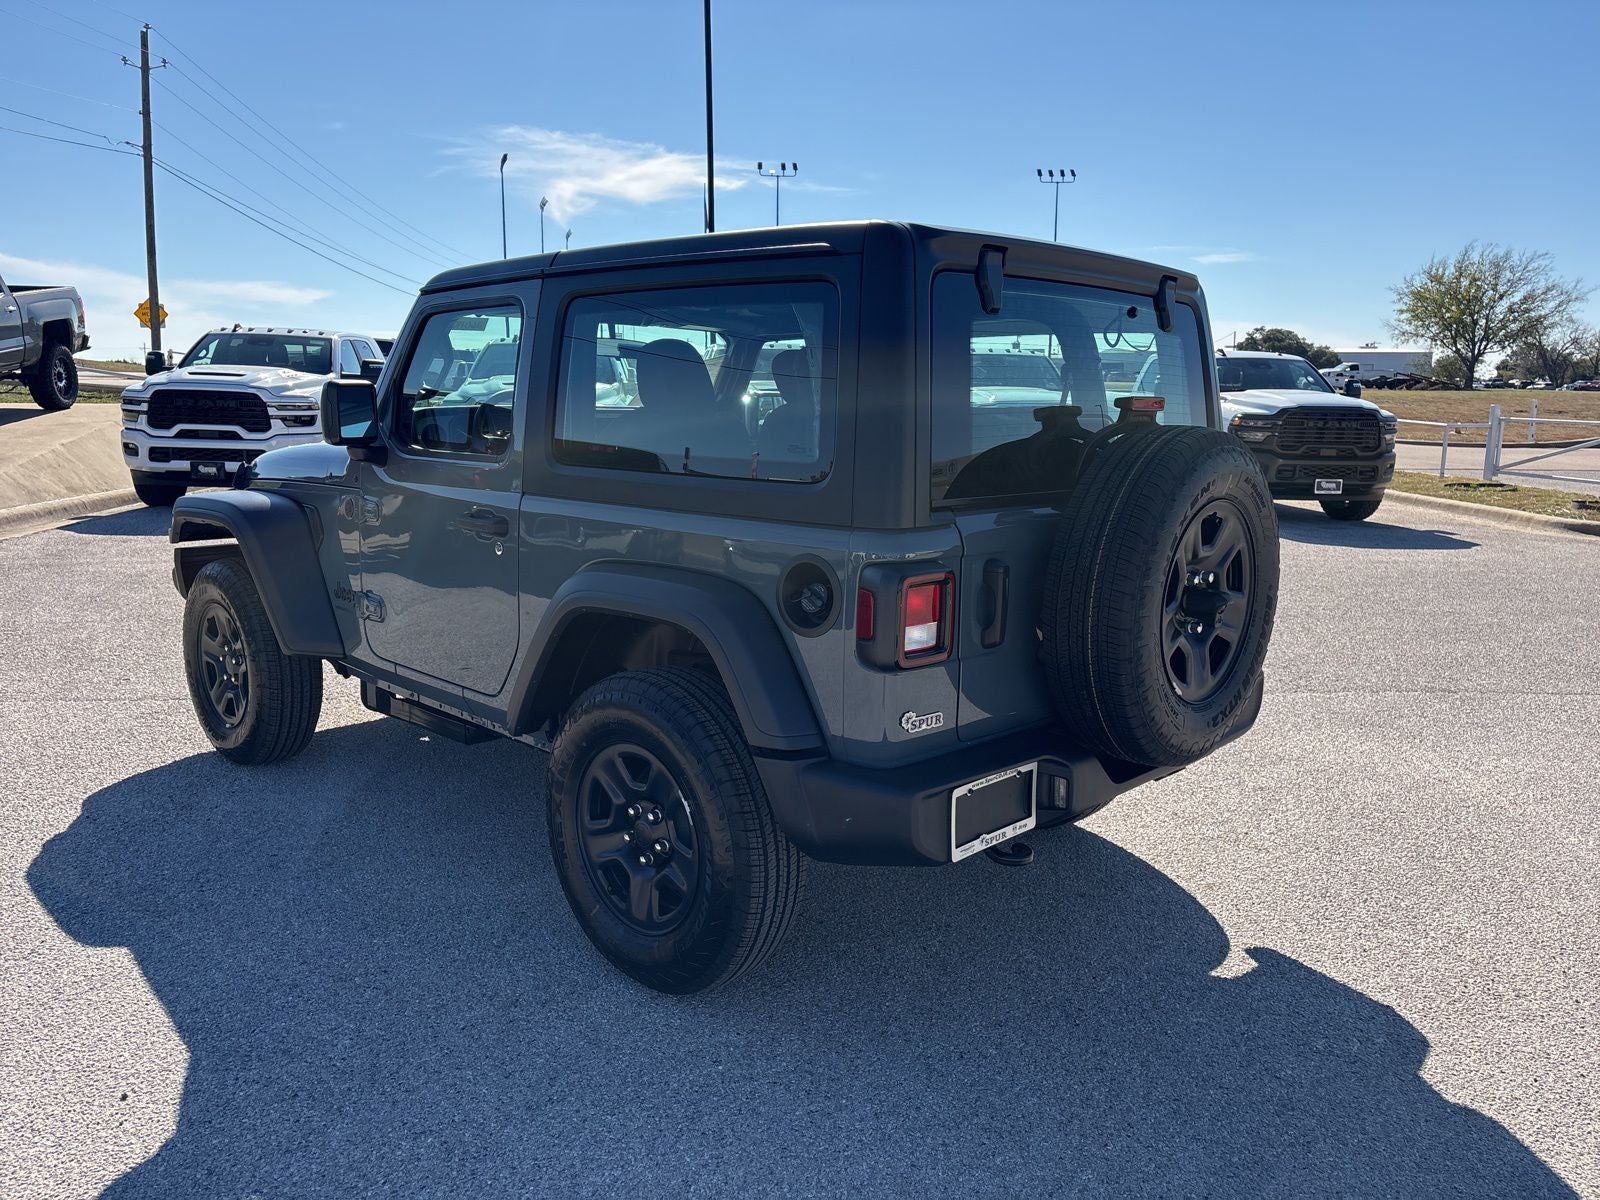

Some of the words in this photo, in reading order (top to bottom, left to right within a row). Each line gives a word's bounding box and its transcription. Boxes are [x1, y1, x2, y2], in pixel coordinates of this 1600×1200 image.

[1308, 420, 1356, 428] RAM
[911, 714, 941, 730] SPUR
[984, 832, 1007, 846] SPUR
